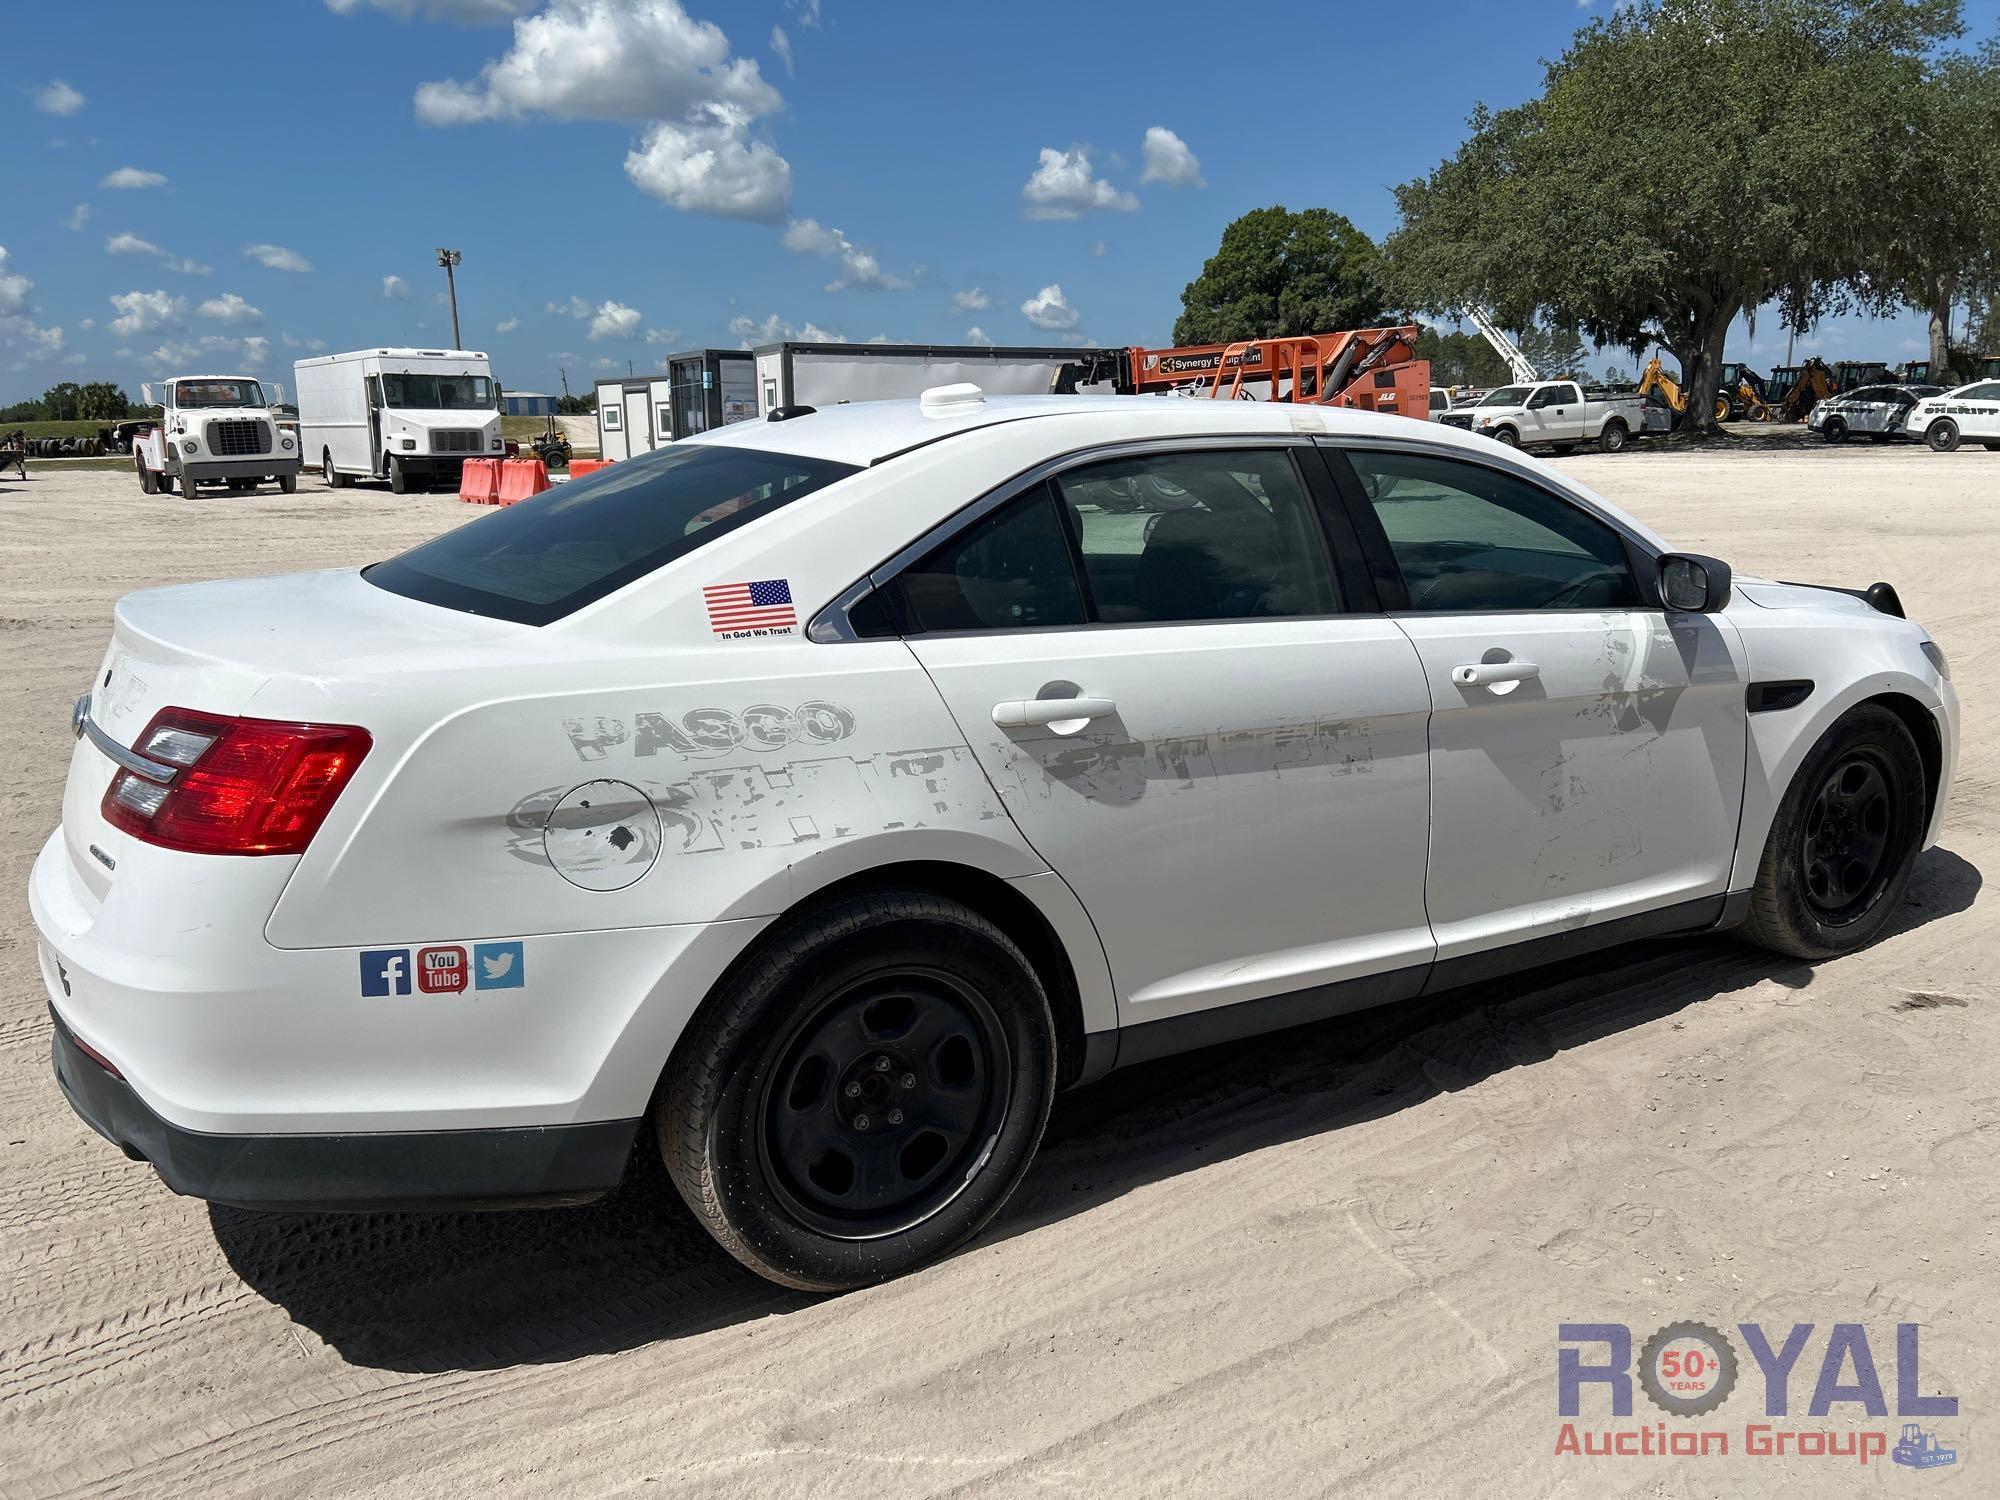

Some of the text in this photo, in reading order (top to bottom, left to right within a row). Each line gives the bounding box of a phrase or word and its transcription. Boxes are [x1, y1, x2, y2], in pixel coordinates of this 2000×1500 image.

[1175, 357, 1211, 370] Synergy
[1377, 392, 1396, 401] JLG
[1818, 406, 1876, 416] SHERIFF
[1924, 406, 2000, 416] SHERIFF
[733, 630, 752, 639] God
[753, 629, 768, 637] We
[769, 626, 792, 635] Trust
[561, 700, 857, 761] PASCO
[429, 953, 455, 968] You
[426, 970, 460, 988] Tube
